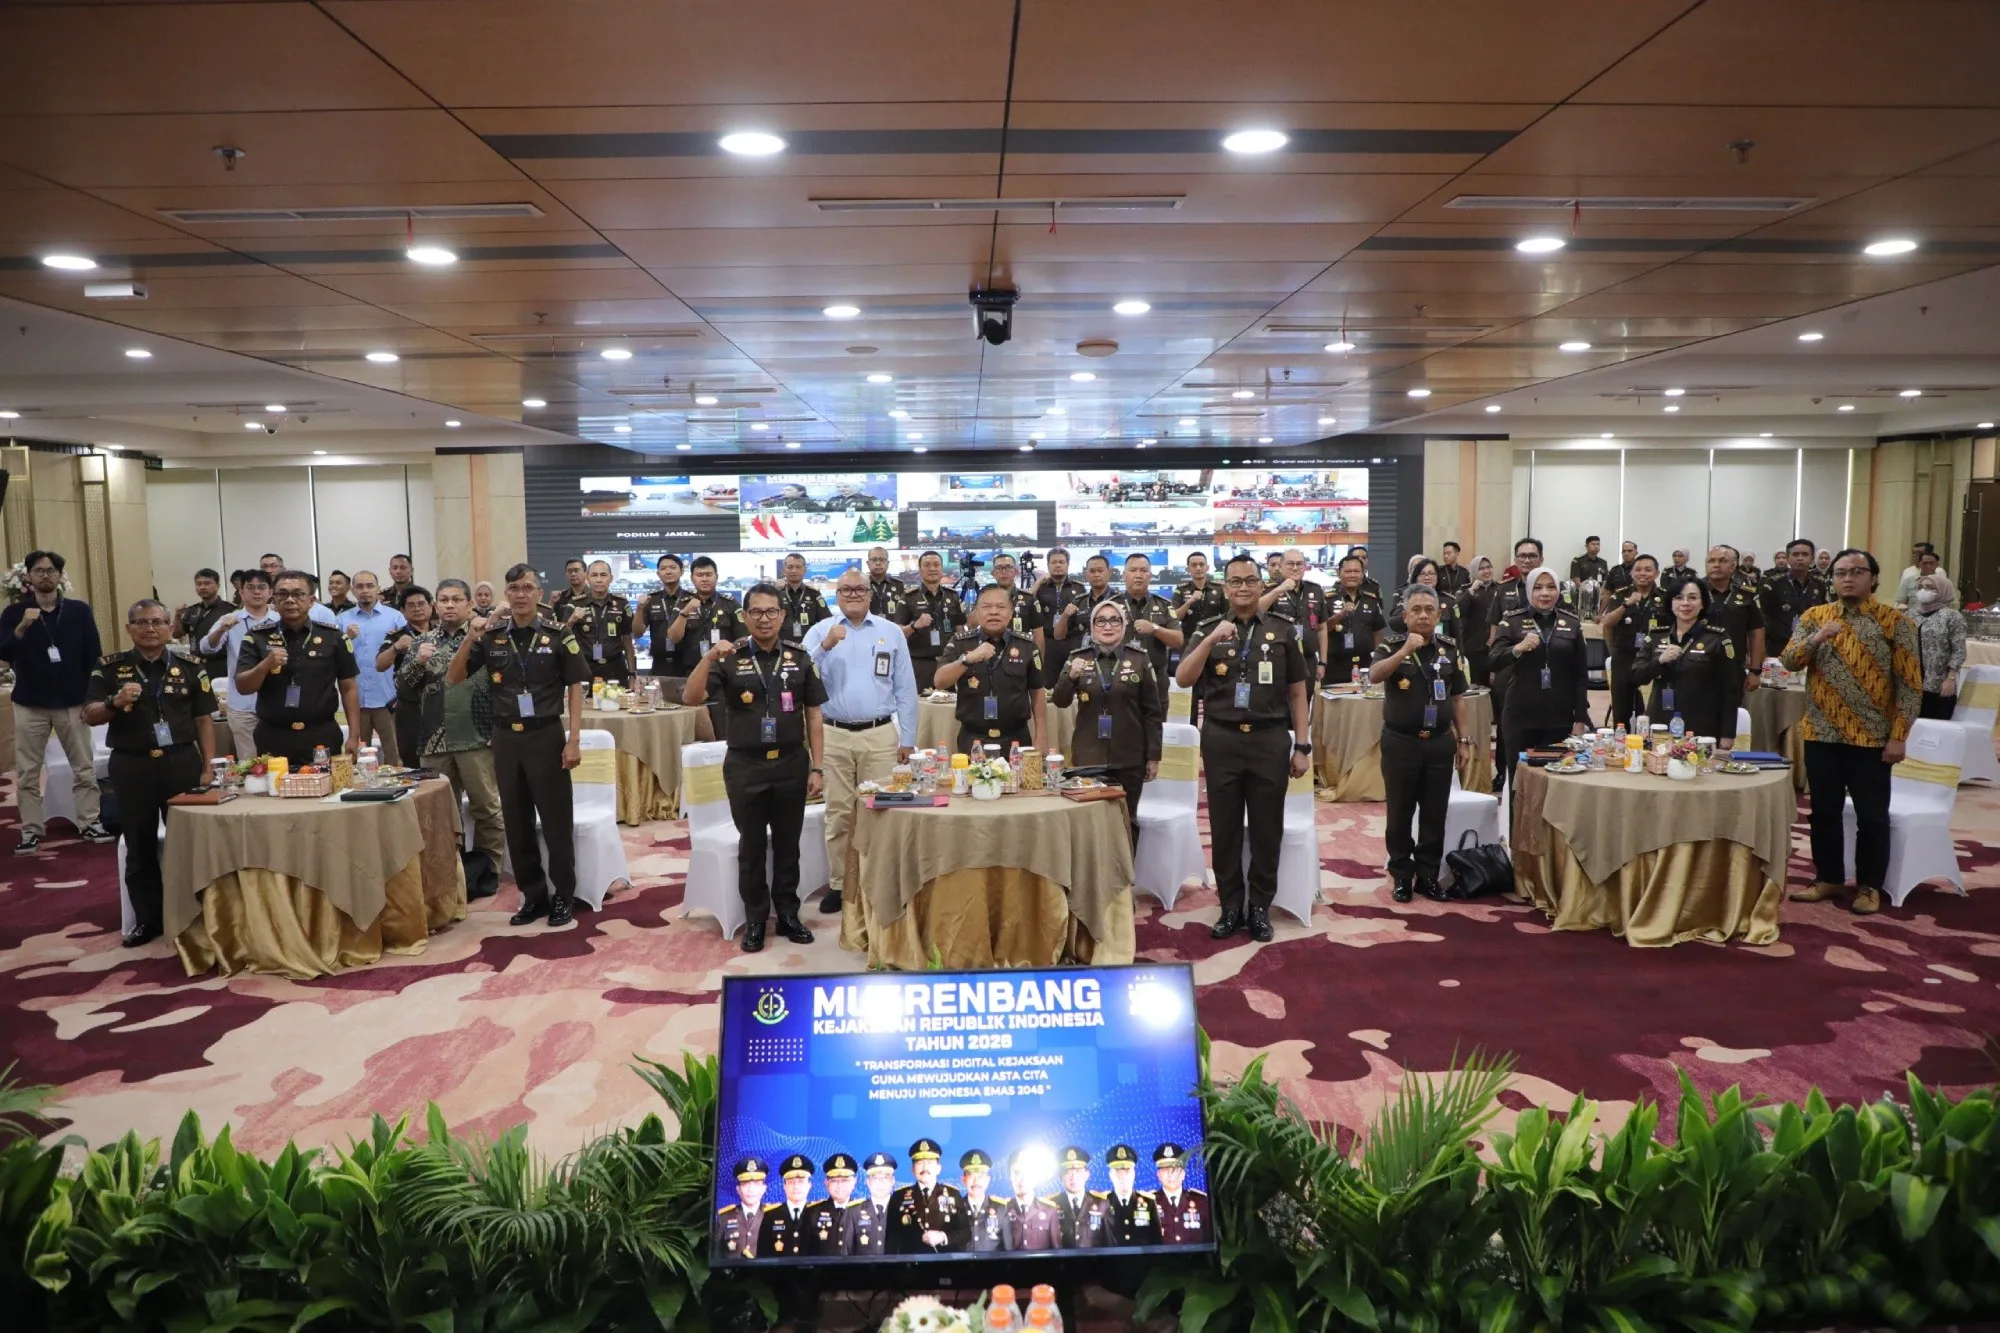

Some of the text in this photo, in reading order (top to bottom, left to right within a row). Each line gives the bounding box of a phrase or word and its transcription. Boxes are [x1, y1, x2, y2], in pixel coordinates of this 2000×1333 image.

[813, 978, 1102, 1018] MURENBANG
[919, 1014, 1006, 1032] REPUBLIK
[1008, 1011, 1105, 1030] INDONESIA
[904, 1035, 964, 1052] TAHUN
[863, 1058, 950, 1071] TRANSFORMASI
[951, 1057, 997, 1069] DIGITAL
[997, 1054, 1063, 1067] KEJAKSAAN
[870, 1069, 1049, 1086] GUNA MEWUJUDKAN ASTA CITA
[868, 1088, 917, 1100] MENUJU
[918, 1086, 982, 1099] INDONESIA
[983, 1085, 1016, 1097] EMAS
